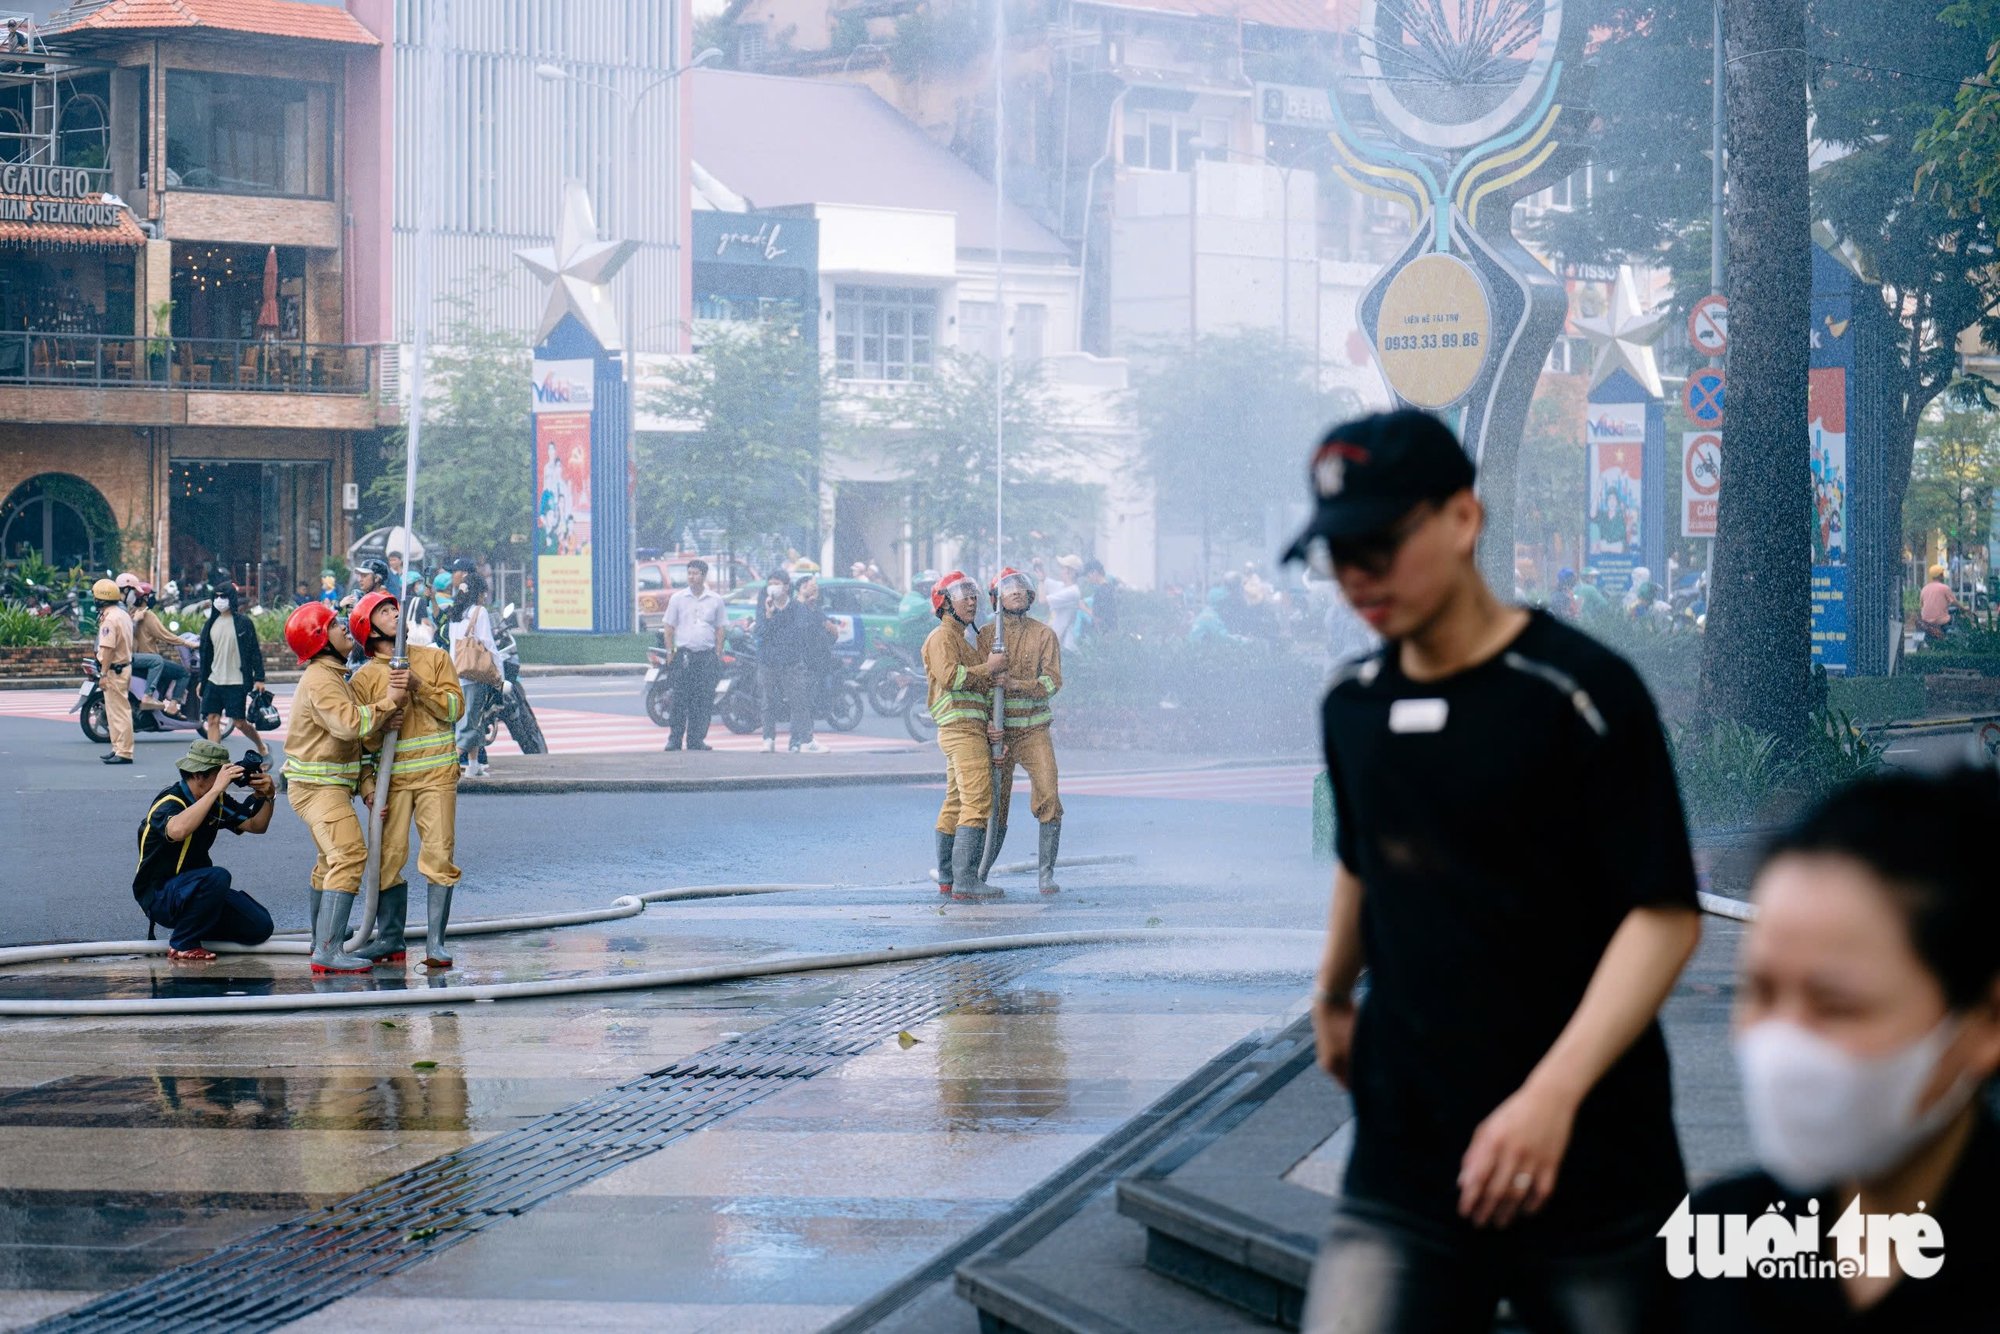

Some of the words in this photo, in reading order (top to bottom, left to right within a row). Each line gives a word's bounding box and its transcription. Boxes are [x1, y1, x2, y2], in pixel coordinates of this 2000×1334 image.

[3, 165, 90, 199] GAUCHO
[32, 201, 121, 226] STEAKHOUSE
[1578, 263, 1617, 280] TISSO
[1384, 331, 1479, 351] 0933.33.99.88
[1587, 412, 1624, 437] Vikki
